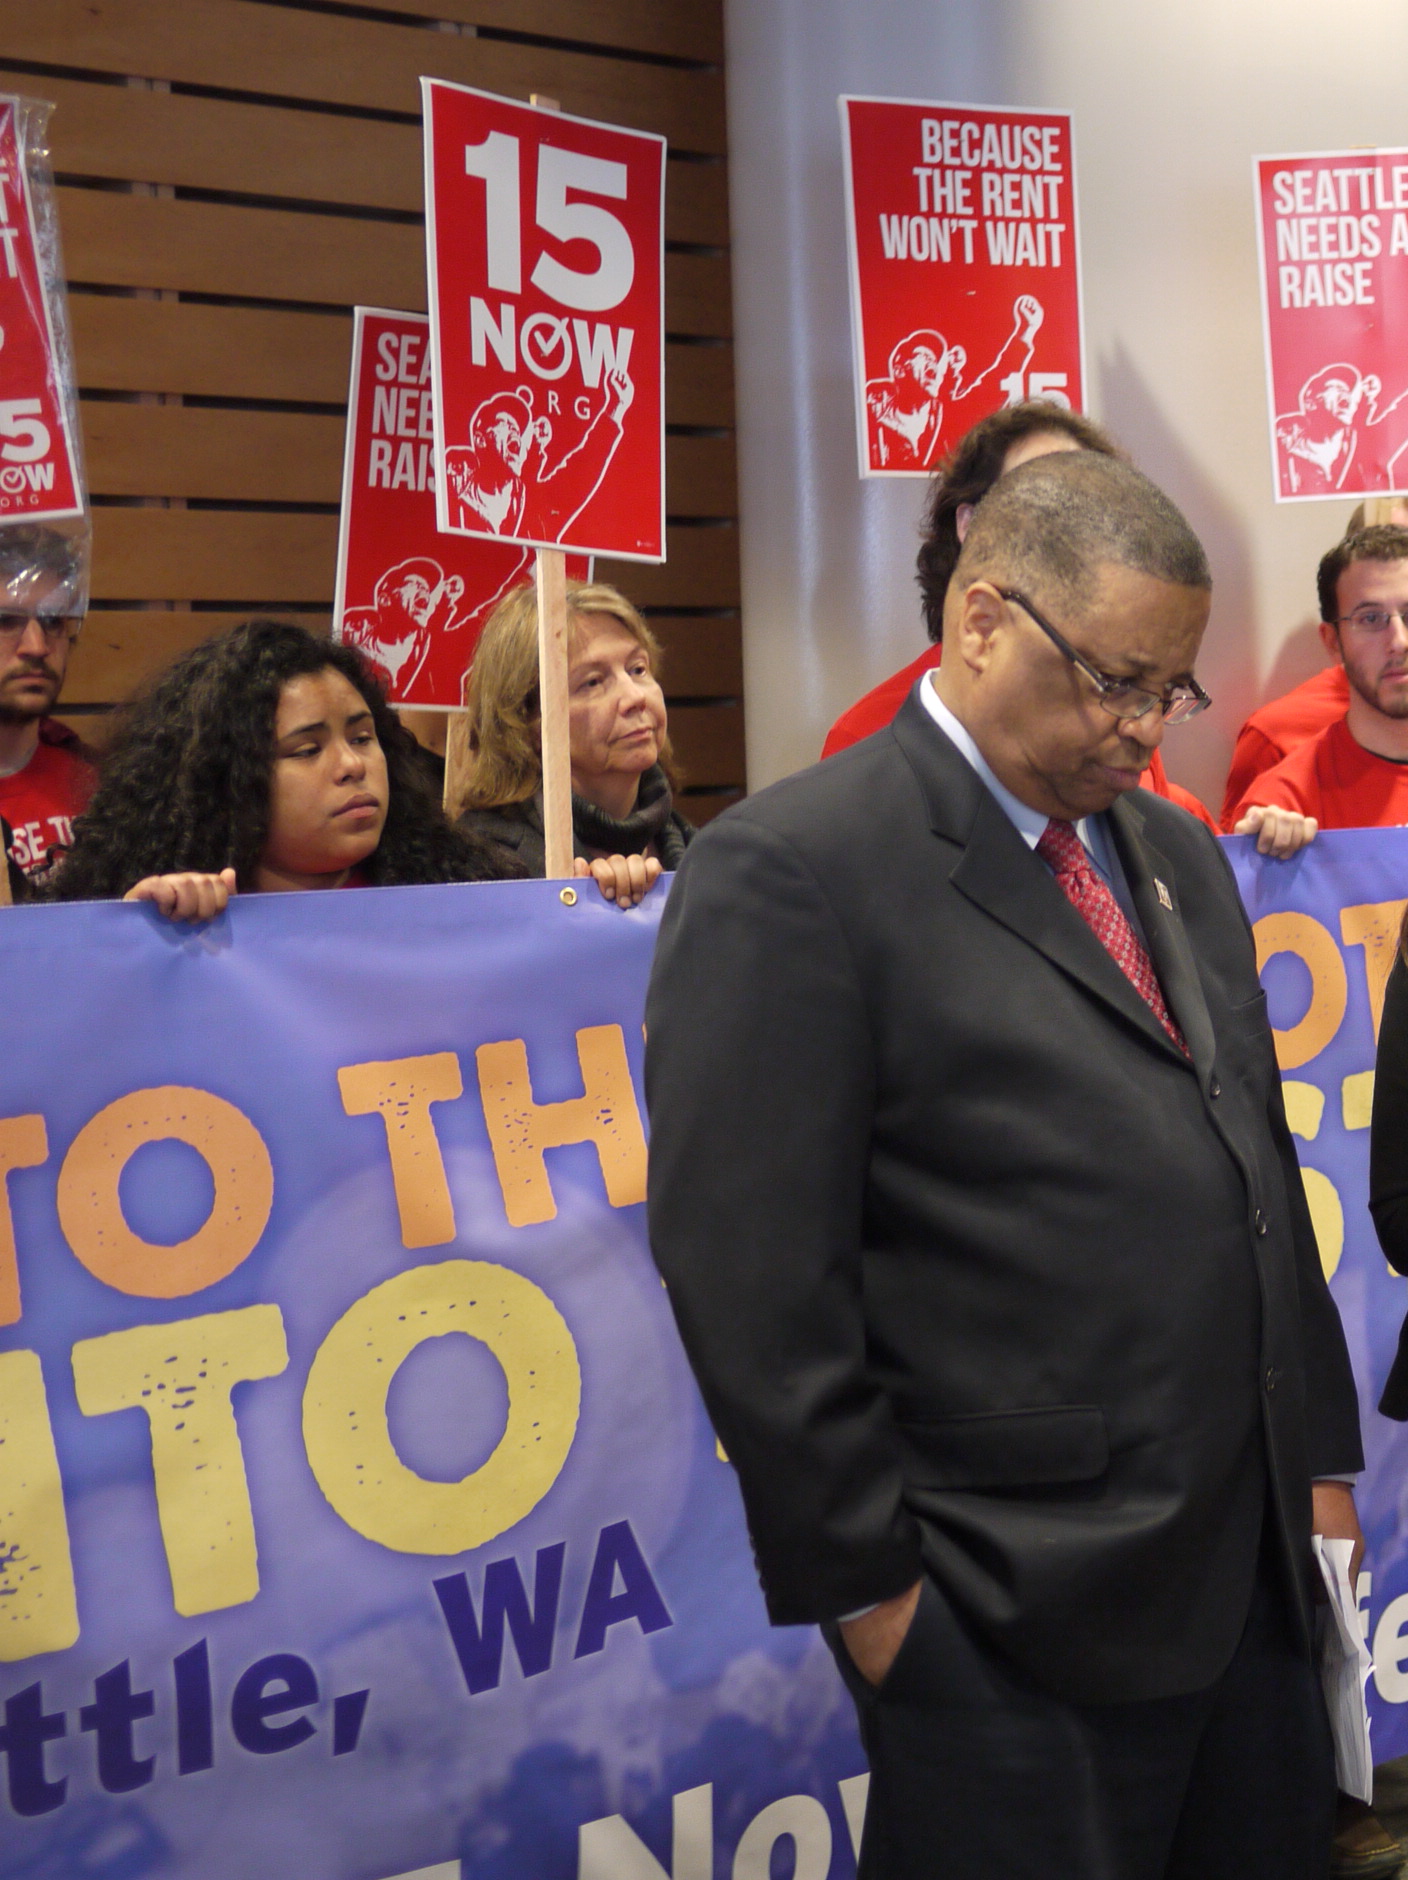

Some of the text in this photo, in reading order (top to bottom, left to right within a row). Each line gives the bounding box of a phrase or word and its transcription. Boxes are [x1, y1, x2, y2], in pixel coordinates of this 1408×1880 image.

[922, 119, 1061, 171] BECAUSE
[913, 167, 1063, 219] THE RENT
[465, 131, 634, 311] 15
[880, 214, 1066, 267] WON'T WAIT
[1276, 214, 1381, 261] NEEDS
[1279, 262, 1374, 308] RAISE
[470, 297, 634, 389] NOW
[1000, 372, 1071, 411] 15
[337, 1023, 648, 1249] TH
[432, 1519, 673, 1696] WA
